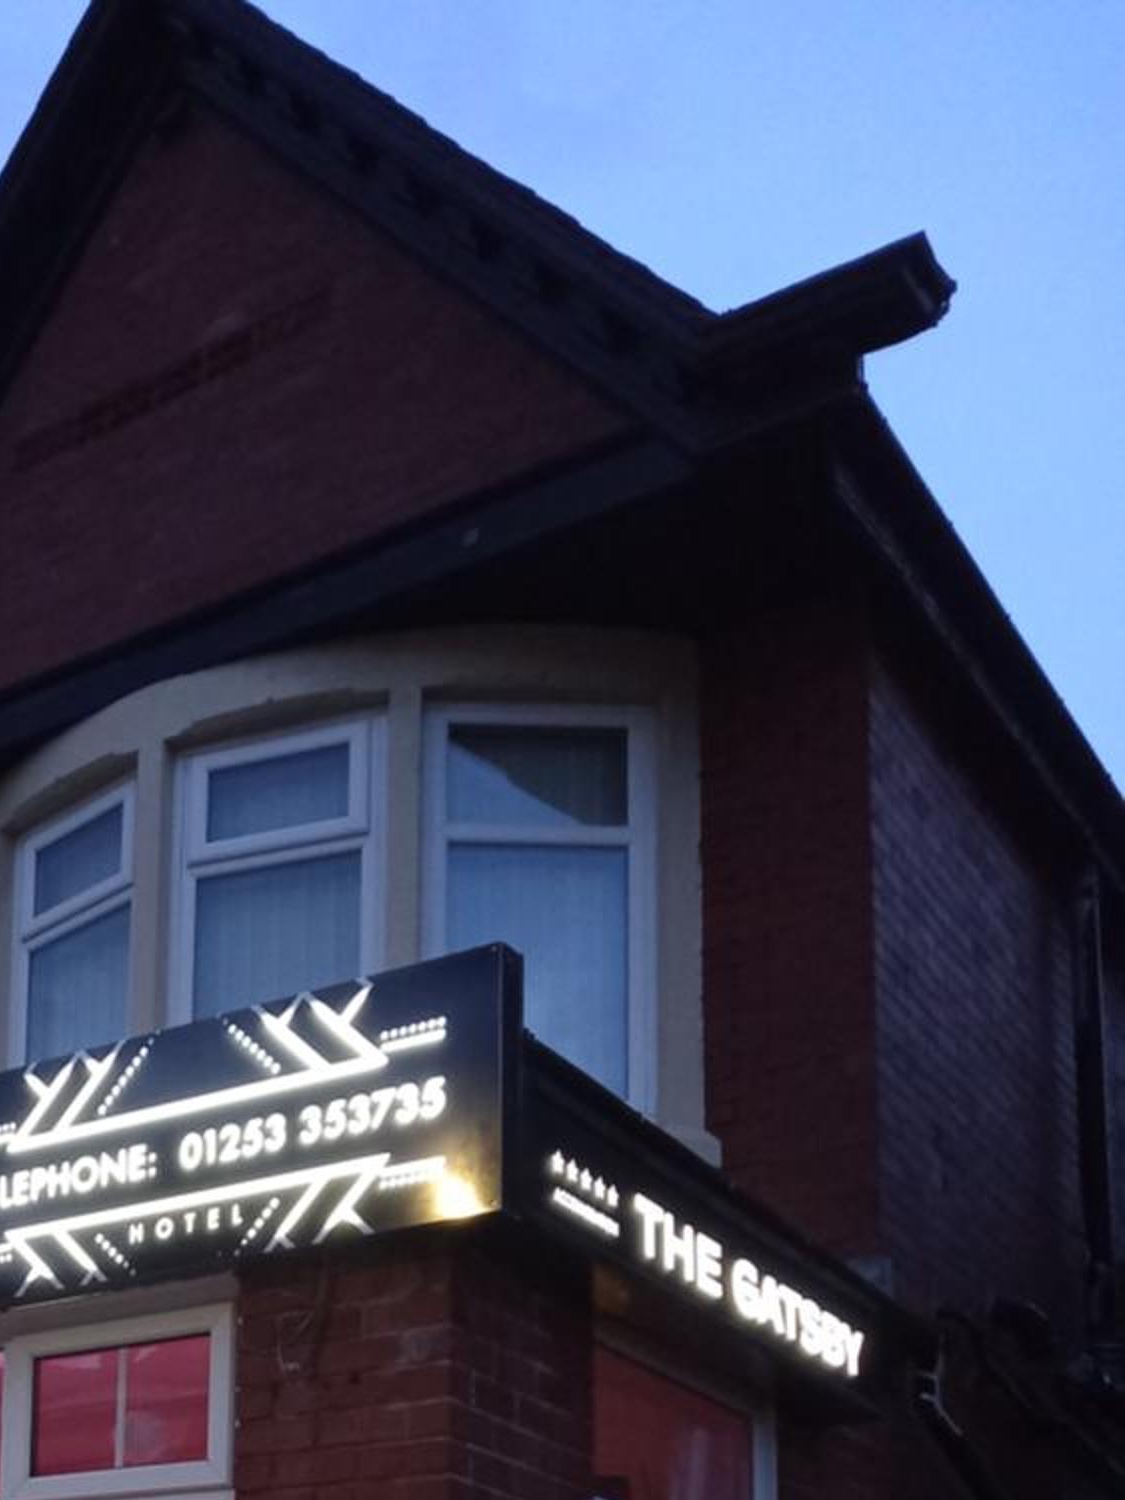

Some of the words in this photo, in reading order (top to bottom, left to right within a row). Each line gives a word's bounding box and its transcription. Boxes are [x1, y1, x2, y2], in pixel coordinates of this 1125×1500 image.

[178, 1111, 287, 1171] 01253
[298, 1075, 447, 1147] 353735
[128, 1202, 244, 1246] HOTEL
[633, 1192, 724, 1300] THE
[731, 1258, 864, 1378] GATSBY
